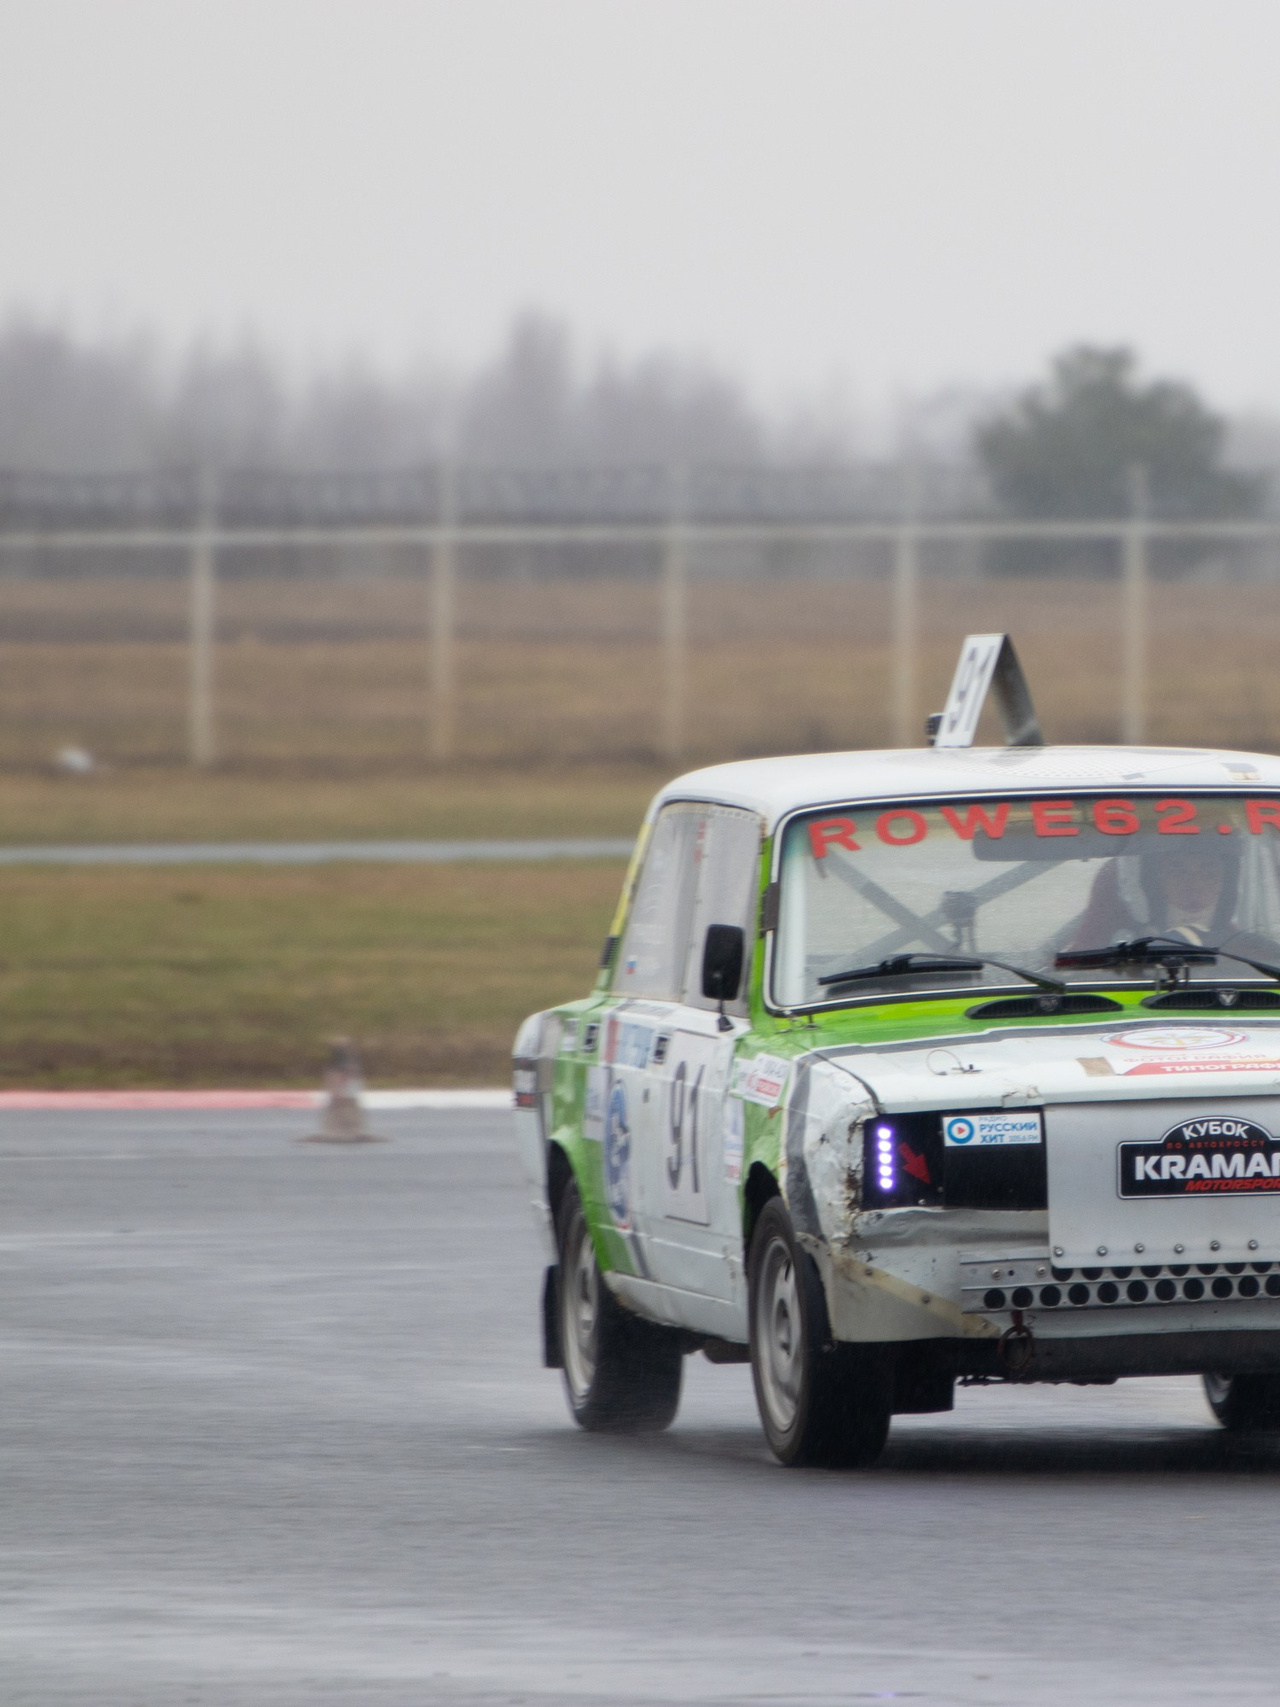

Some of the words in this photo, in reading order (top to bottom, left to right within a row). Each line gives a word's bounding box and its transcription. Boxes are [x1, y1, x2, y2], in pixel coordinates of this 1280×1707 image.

[666, 1060, 706, 1193] 91
[979, 1121, 1038, 1132] РУССКИЙ
[1182, 1121, 1250, 1141] КУБОК
[980, 1133, 1005, 1144] ХИТ
